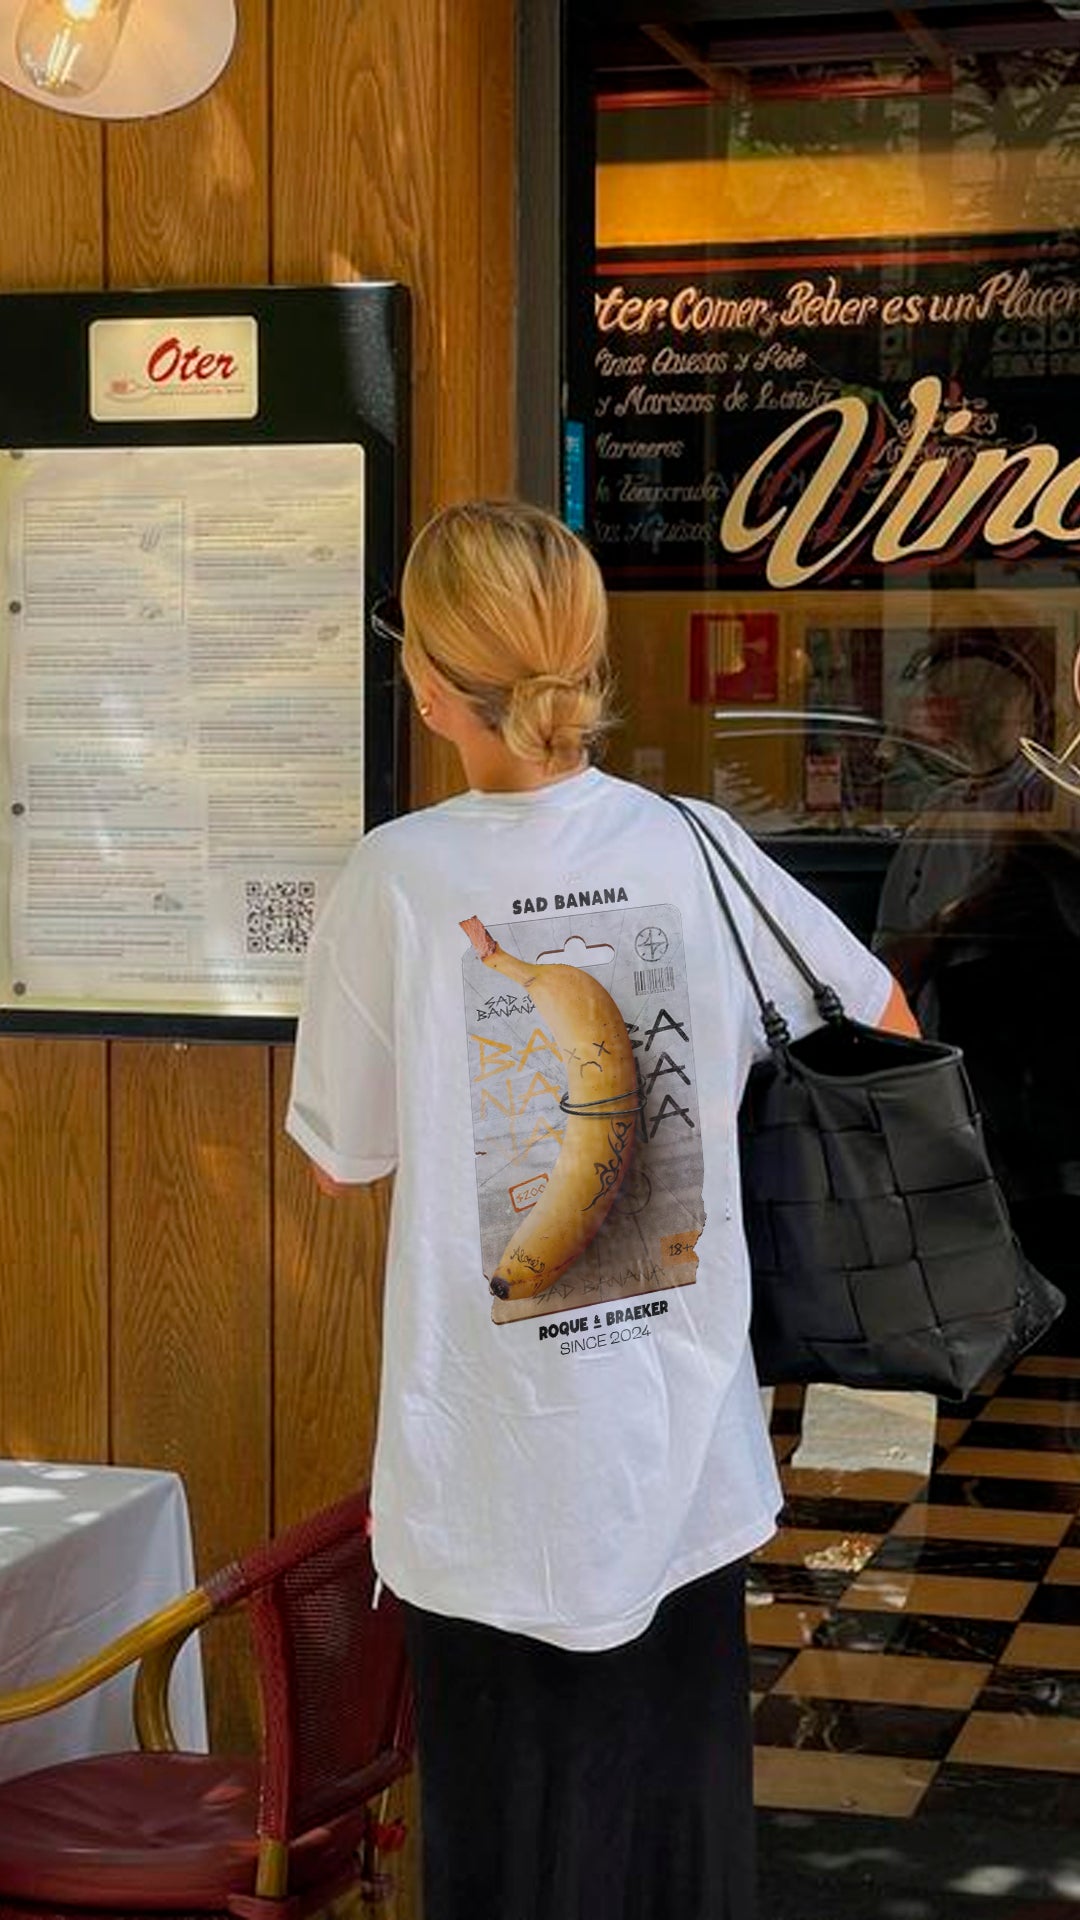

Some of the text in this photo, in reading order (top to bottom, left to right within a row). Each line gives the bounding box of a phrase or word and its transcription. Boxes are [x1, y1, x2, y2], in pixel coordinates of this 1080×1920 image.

[594, 286, 668, 332] ter.
[670, 286, 768, 331] Comer
[780, 276, 877, 326] Beber
[881, 293, 923, 325] es
[927, 293, 976, 323] un
[974, 267, 1080, 320] Placer
[147, 336, 239, 382] Oter
[652, 346, 728, 376] Quesos
[613, 384, 716, 417] Mariscos
[512, 886, 629, 915] SAD BANANA
[484, 994, 518, 1009] SAD
[469, 1027, 564, 1083] BA
[479, 1071, 563, 1121] NA
[538, 1299, 669, 1341] ROQUE & BRAEKER
[560, 1323, 652, 1356] SINCE 2024
